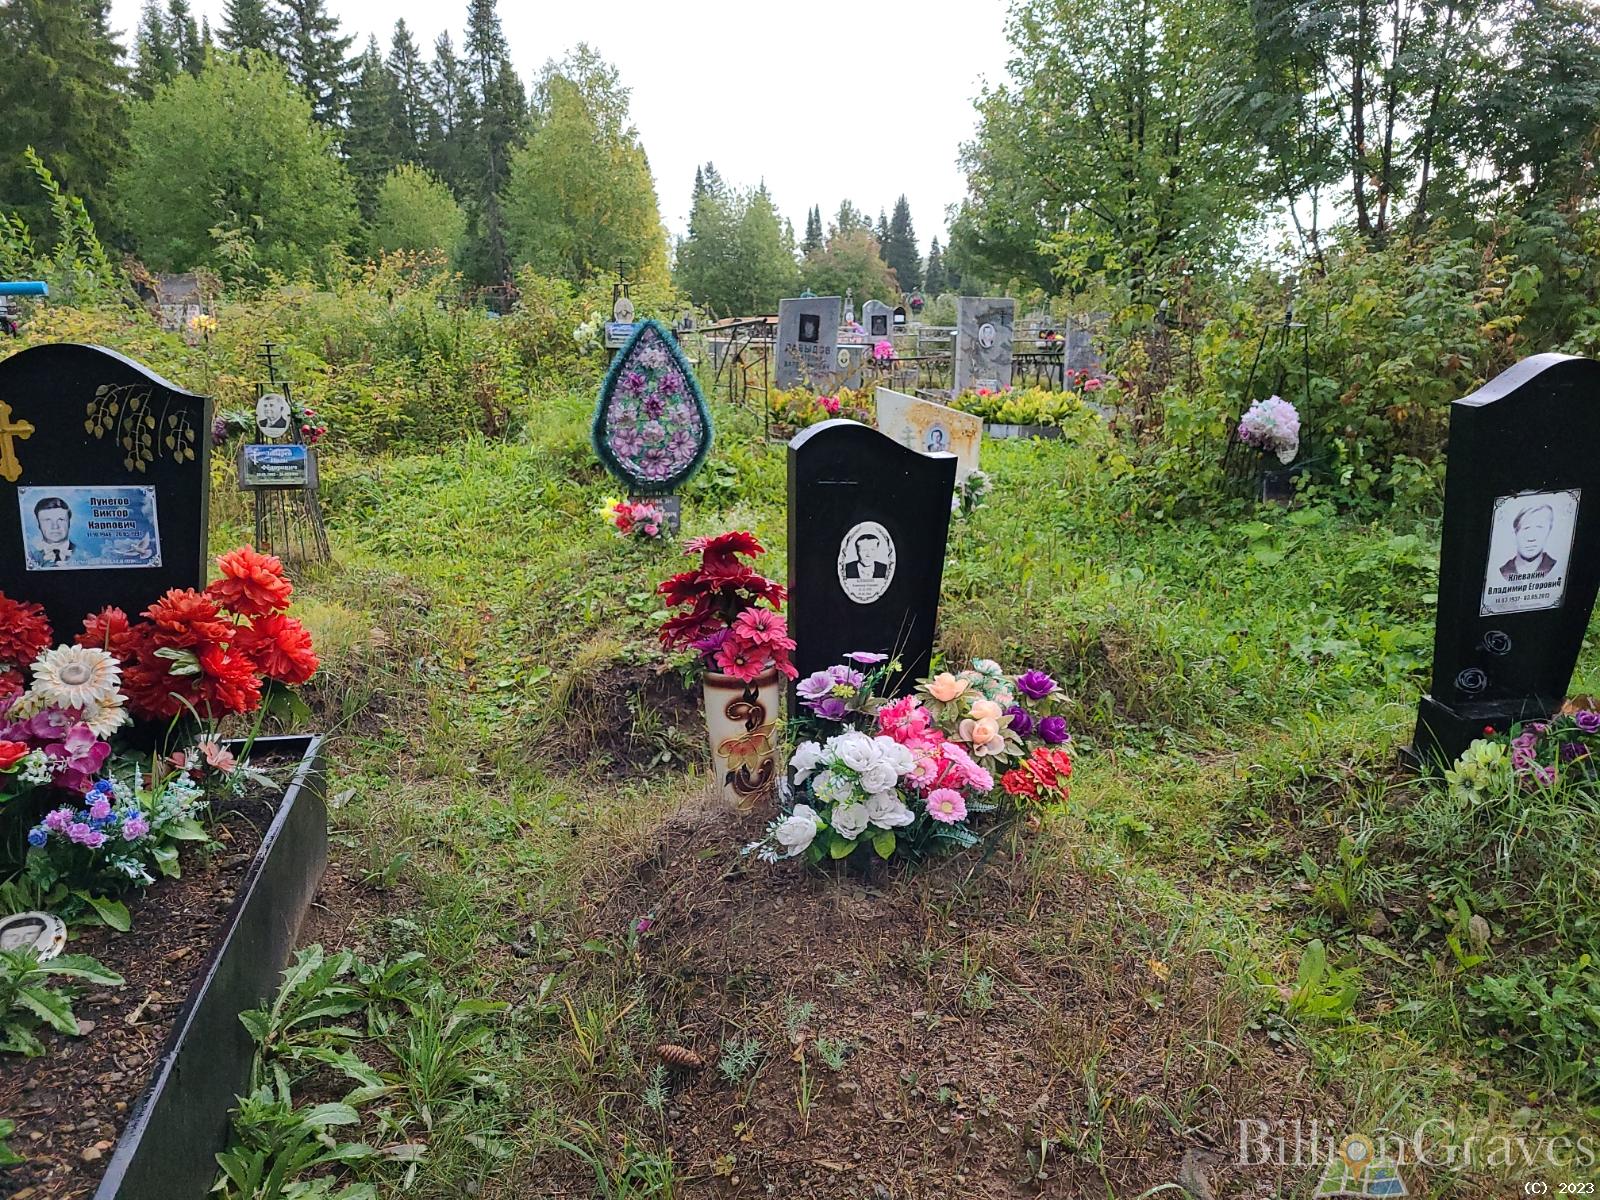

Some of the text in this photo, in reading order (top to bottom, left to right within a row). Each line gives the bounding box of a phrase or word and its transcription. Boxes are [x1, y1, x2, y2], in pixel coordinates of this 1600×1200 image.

[93, 509, 129, 518] Виктор
[88, 521, 136, 530] Карпович
[1508, 571, 1545, 582] Клевакин
[1487, 580, 1562, 595] Владимир Егорович
